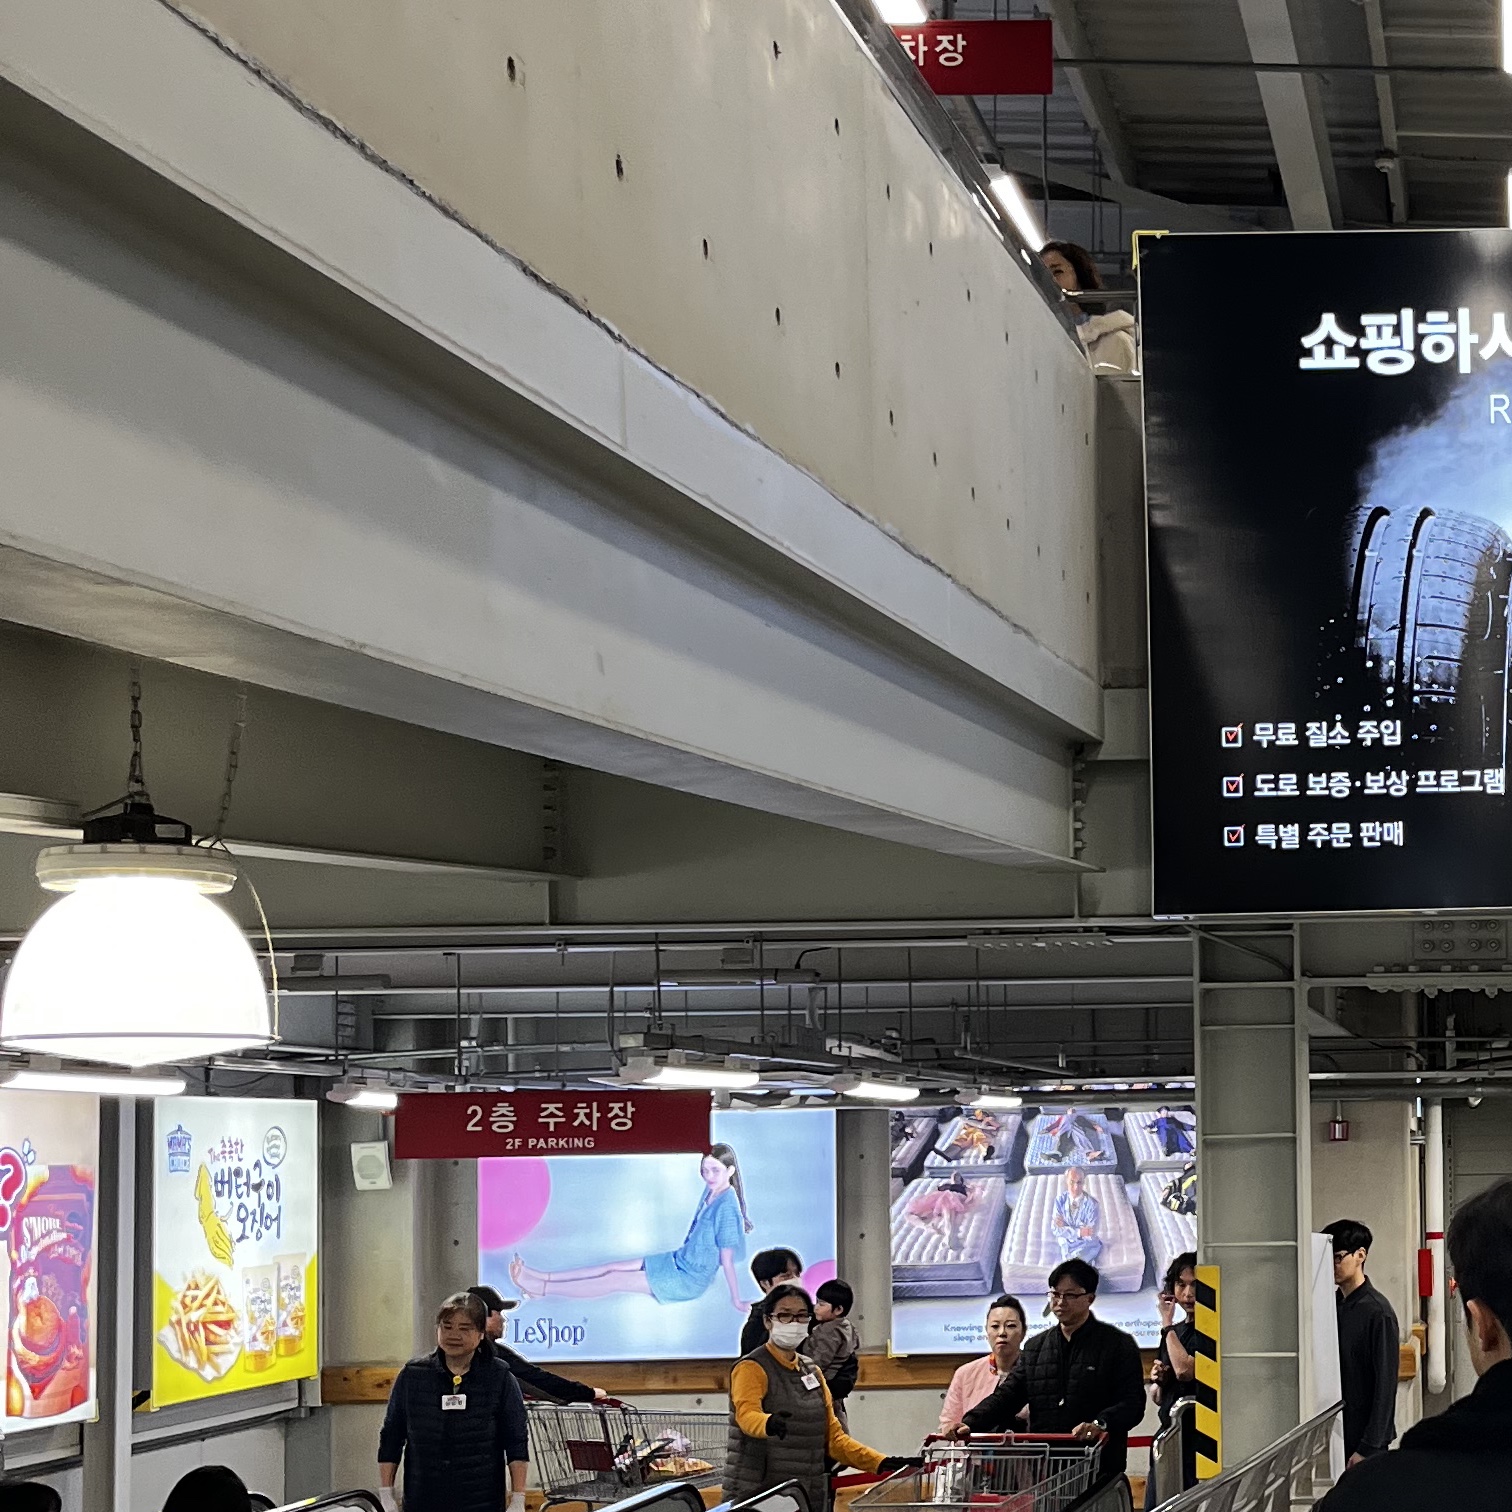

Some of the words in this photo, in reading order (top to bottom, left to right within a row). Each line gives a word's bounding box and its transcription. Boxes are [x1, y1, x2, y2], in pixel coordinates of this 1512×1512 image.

[900, 33, 968, 67] 차장
[1252, 721, 1299, 749] 무료
[1304, 721, 1352, 748] 질소
[1356, 719, 1402, 747] 주입
[1253, 773, 1300, 797] 도로
[1415, 767, 1505, 794] 프로그램
[1254, 823, 1300, 850] 특별
[1306, 822, 1353, 849] 주문
[1359, 820, 1405, 847] 판매
[466, 1102, 518, 1134] 2층
[538, 1100, 636, 1132] 주차장
[505, 1138, 523, 1150] 2F
[528, 1137, 595, 1149] PARKING
[213, 1158, 281, 1209] 버터구이
[235, 1201, 282, 1243] 오징어
[513, 1317, 586, 1350] LeShop
